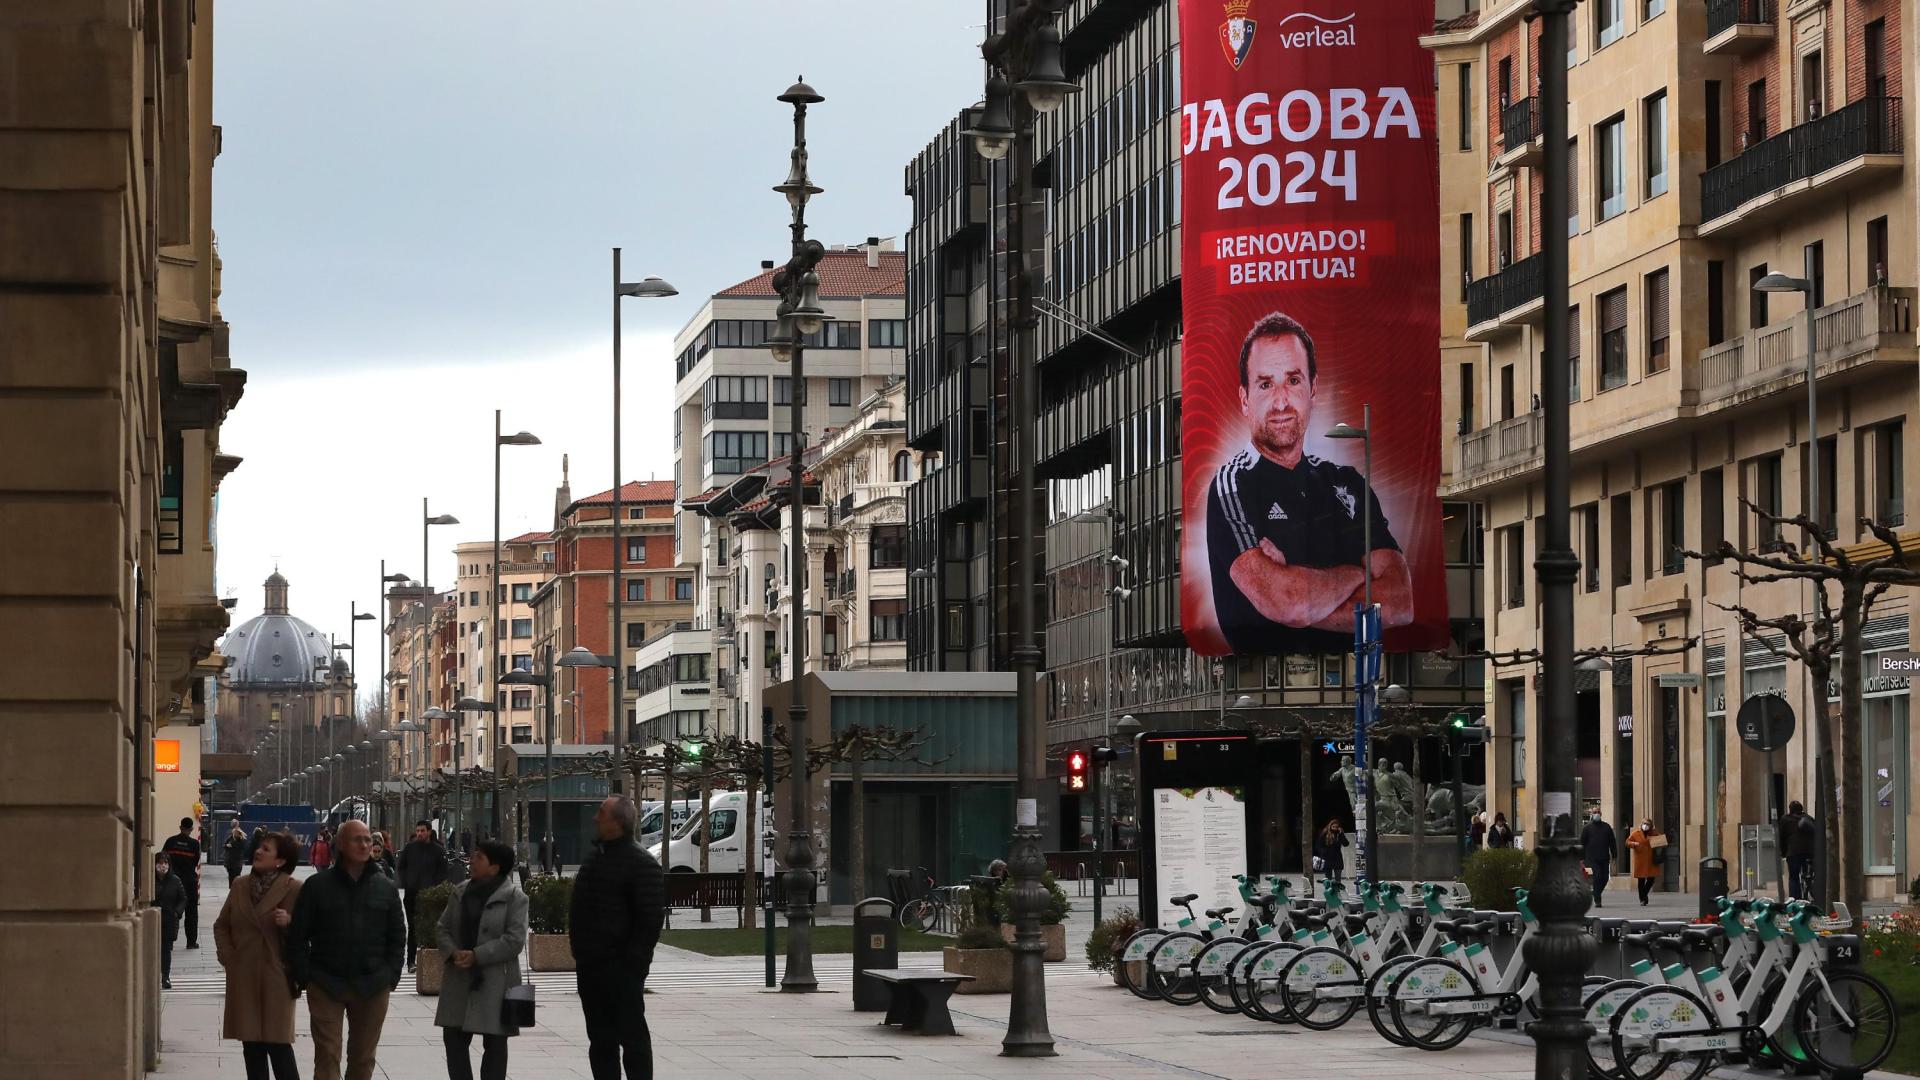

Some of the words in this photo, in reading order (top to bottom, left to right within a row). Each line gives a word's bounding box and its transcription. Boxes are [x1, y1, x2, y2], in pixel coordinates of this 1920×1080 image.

[1280, 25, 1356, 48] verleal
[1183, 87, 1421, 156] JAGOBA
[1217, 150, 1357, 210] 2024
[1216, 229, 1366, 259] ¡RENOVADO!
[1230, 257, 1356, 285] BERRITUA!
[1658, 622, 1666, 638] 5
[1882, 657, 1920, 670] Bershk
[1837, 946, 1852, 958] 24
[1472, 1002, 1490, 1010] 0113
[1706, 1039, 1727, 1048] 0246
